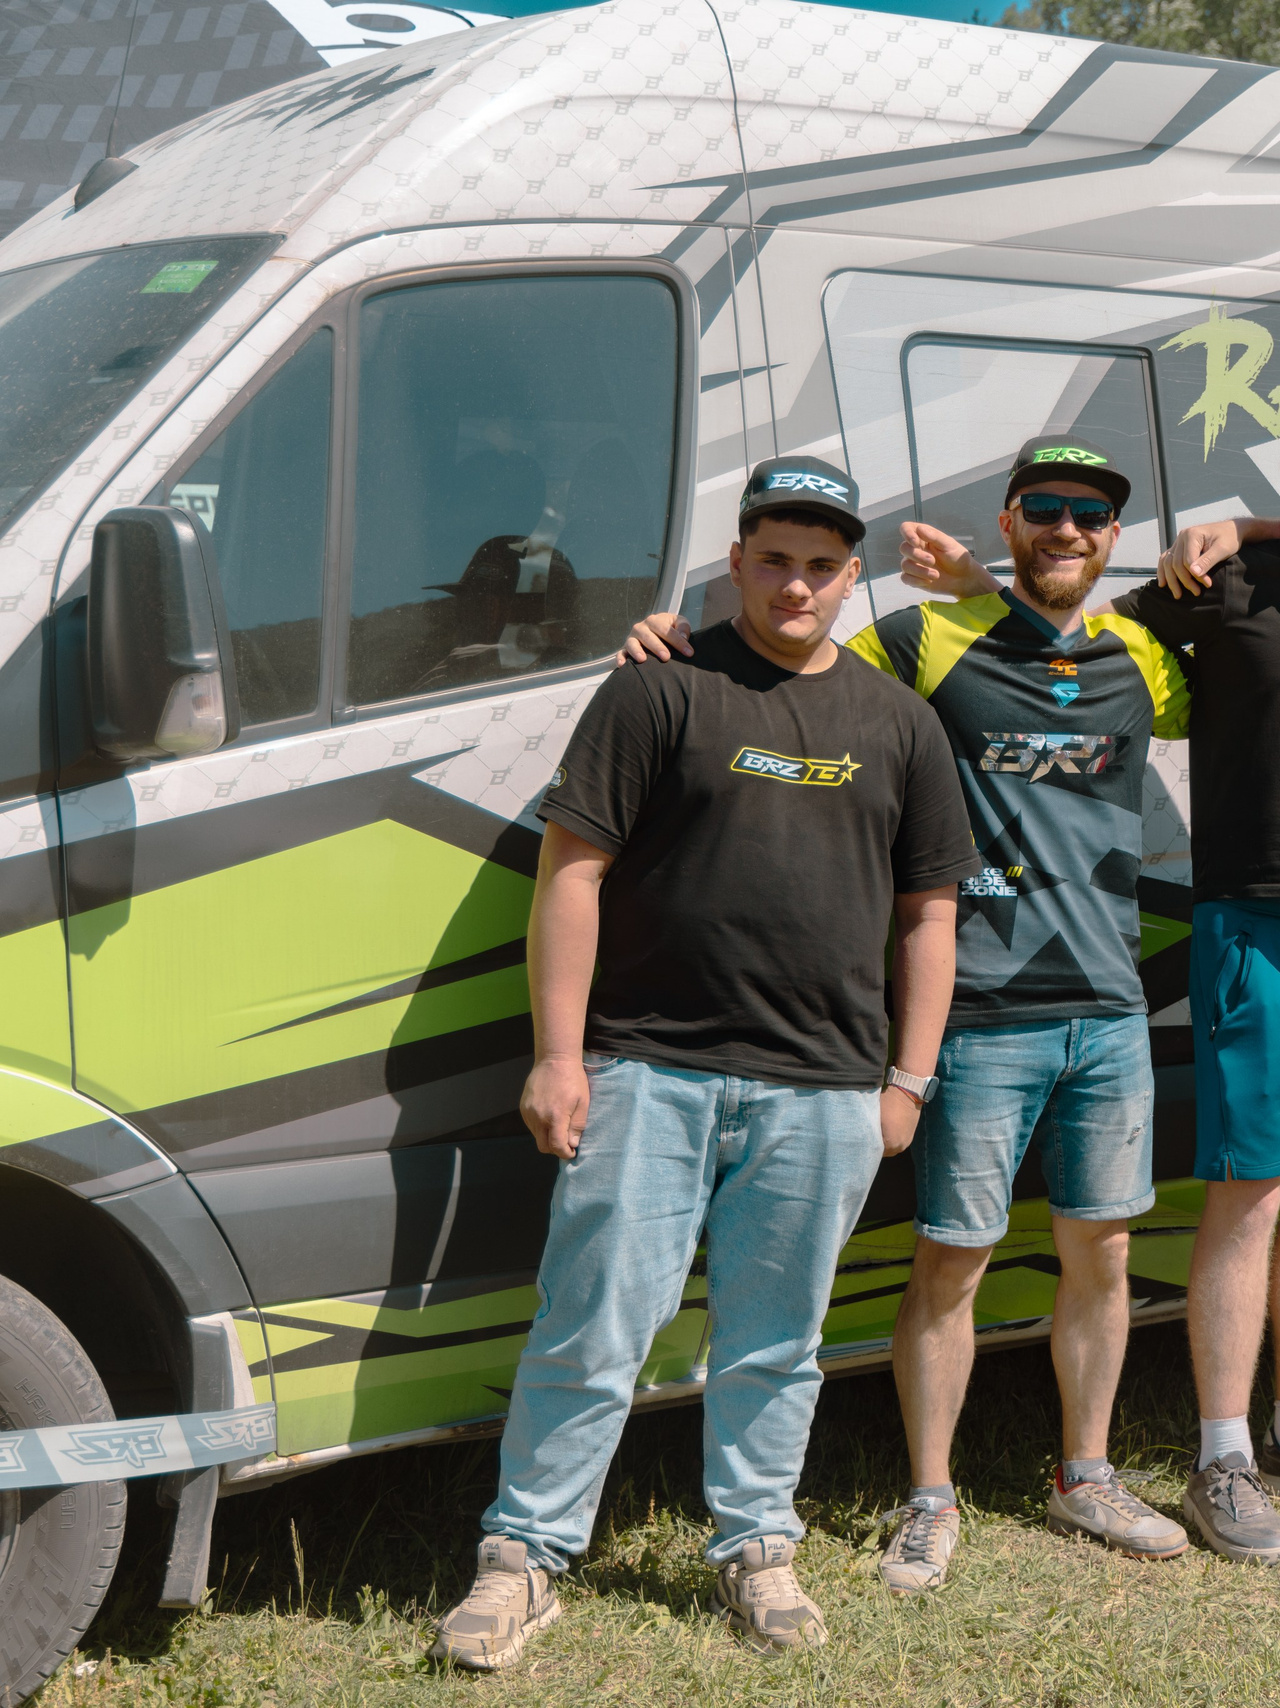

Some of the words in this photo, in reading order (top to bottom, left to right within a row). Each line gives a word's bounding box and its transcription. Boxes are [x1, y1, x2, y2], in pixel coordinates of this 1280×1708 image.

[1033, 447, 1108, 466] BRZ
[768, 473, 849, 504] BRZ
[743, 752, 804, 777] BRZ
[976, 732, 1131, 784] BRZ
[961, 885, 1018, 896] ZONE
